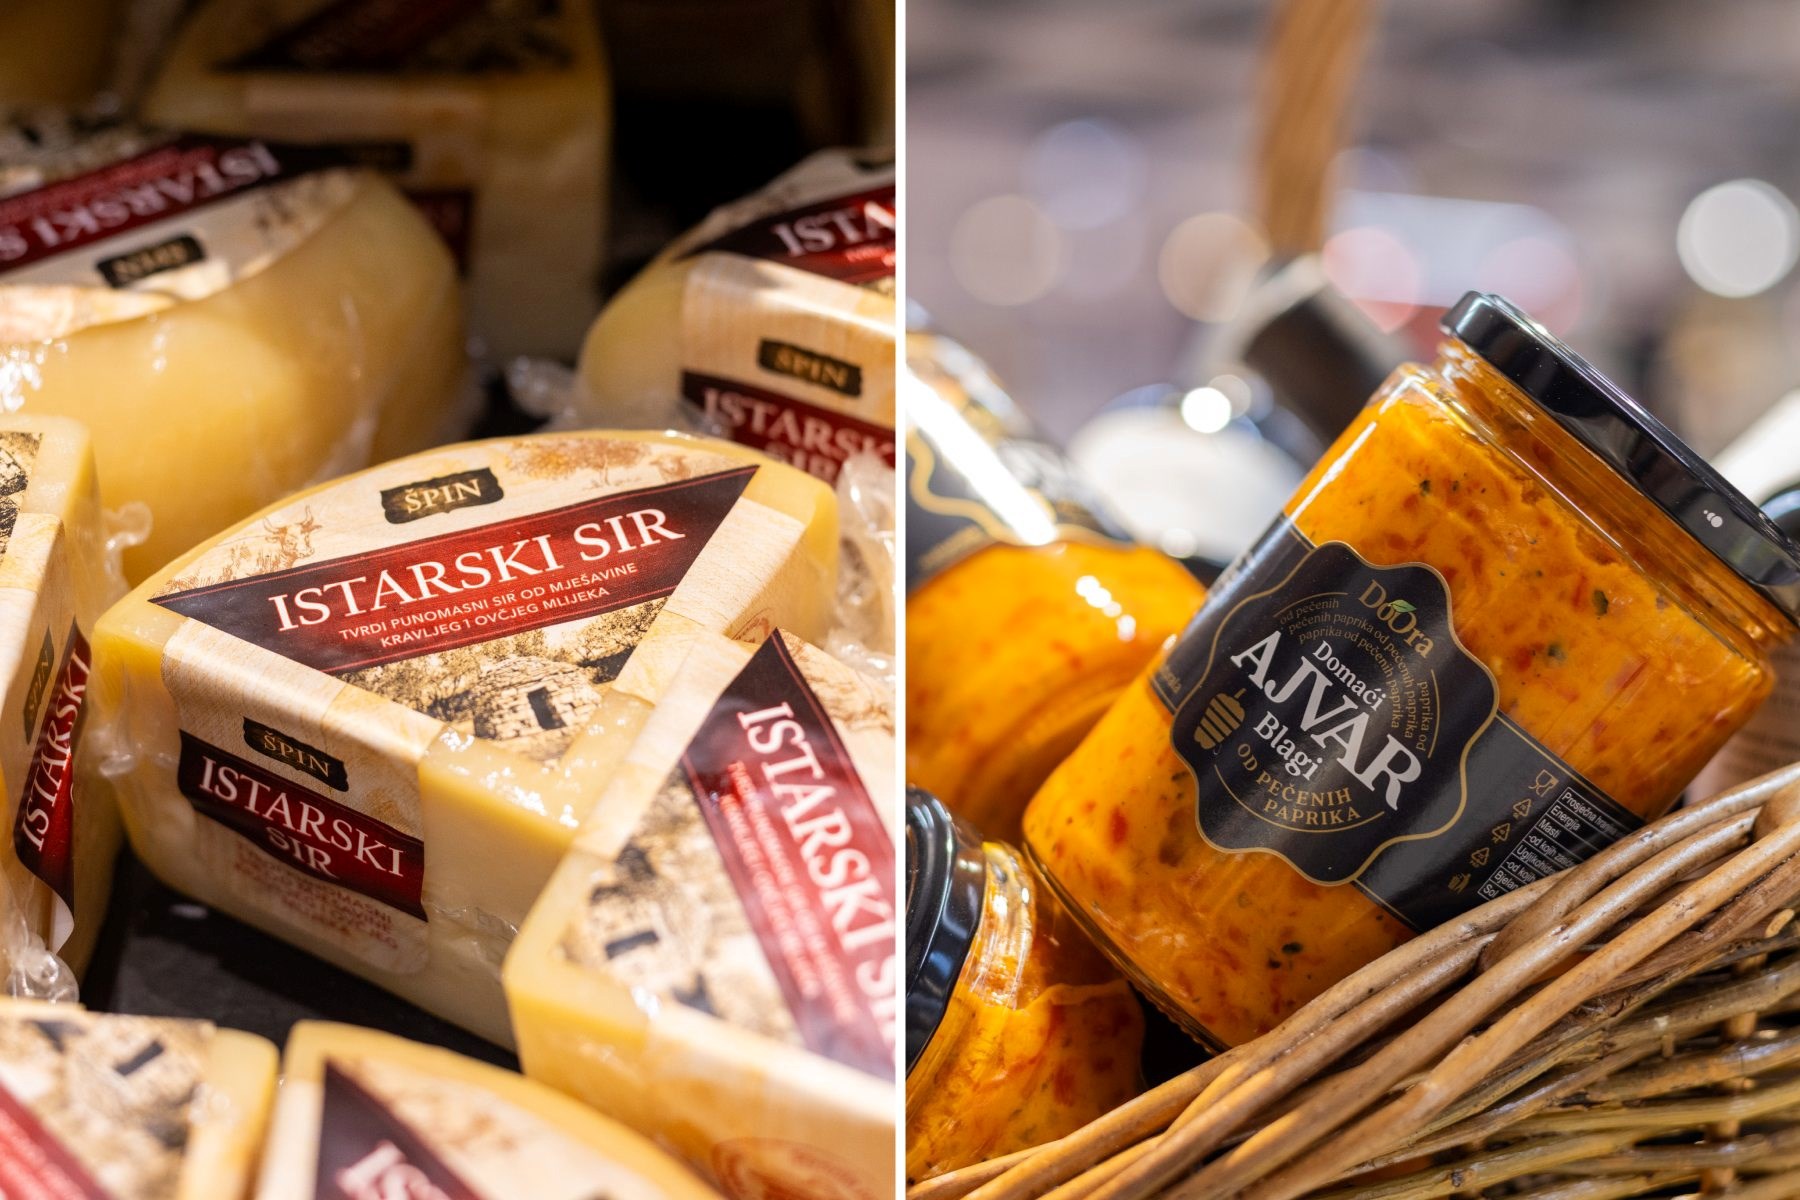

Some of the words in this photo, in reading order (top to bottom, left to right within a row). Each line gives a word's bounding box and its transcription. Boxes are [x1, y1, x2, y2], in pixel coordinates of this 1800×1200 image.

[404, 479, 482, 514] ŠPIN
[268, 534, 564, 632] ISTARSKI
[572, 507, 686, 563] SIR
[339, 621, 387, 641] TVRDI
[390, 598, 488, 629] PUNOMASNI
[493, 590, 517, 608] SIR
[521, 585, 546, 601] OD
[549, 562, 638, 595] MJEŠAVINE
[380, 619, 461, 648] KRAVLJEG
[474, 601, 539, 626] OVČJEG
[542, 587, 611, 610] MLIJEKA
[1280, 610, 1294, 625] od
[1296, 598, 1339, 619] pečenih
[1288, 612, 1331, 635] pečenih
[1333, 614, 1374, 631] paprika
[1374, 630, 1390, 644] od
[1383, 642, 1416, 688] pečenih
[1404, 690, 1418, 739] paprika
[1299, 626, 1342, 645] paprika
[1343, 630, 1359, 642] od
[1357, 639, 1394, 678] pečenih
[1386, 679, 1404, 729] paprika
[1312, 640, 1387, 711] Domaći
[1230, 630, 1422, 811] AJVAR
[1416, 681, 1433, 731] paprika
[22, 648, 91, 852] ISTARSKI
[263, 732, 331, 778] ŠPIN
[1253, 710, 1323, 781] Blagi
[1416, 734, 1428, 751] od
[1237, 743, 1258, 771] OD
[1256, 770, 1353, 807] PEČENIH
[198, 755, 404, 877] ISTARSKI
[737, 702, 895, 950] ISTARSKI
[1263, 799, 1361, 825] PAPRIKA
[1538, 818, 1562, 838] Masti
[1550, 804, 1581, 832] Energija
[1561, 791, 1597, 821] Prosječna
[265, 826, 341, 880] SIR
[1505, 861, 1520, 872] -od
[1519, 866, 1536, 882] kojih
[1528, 835, 1543, 846] -od
[1539, 840, 1557, 857] kojih
[1482, 883, 1499, 898] Sol
